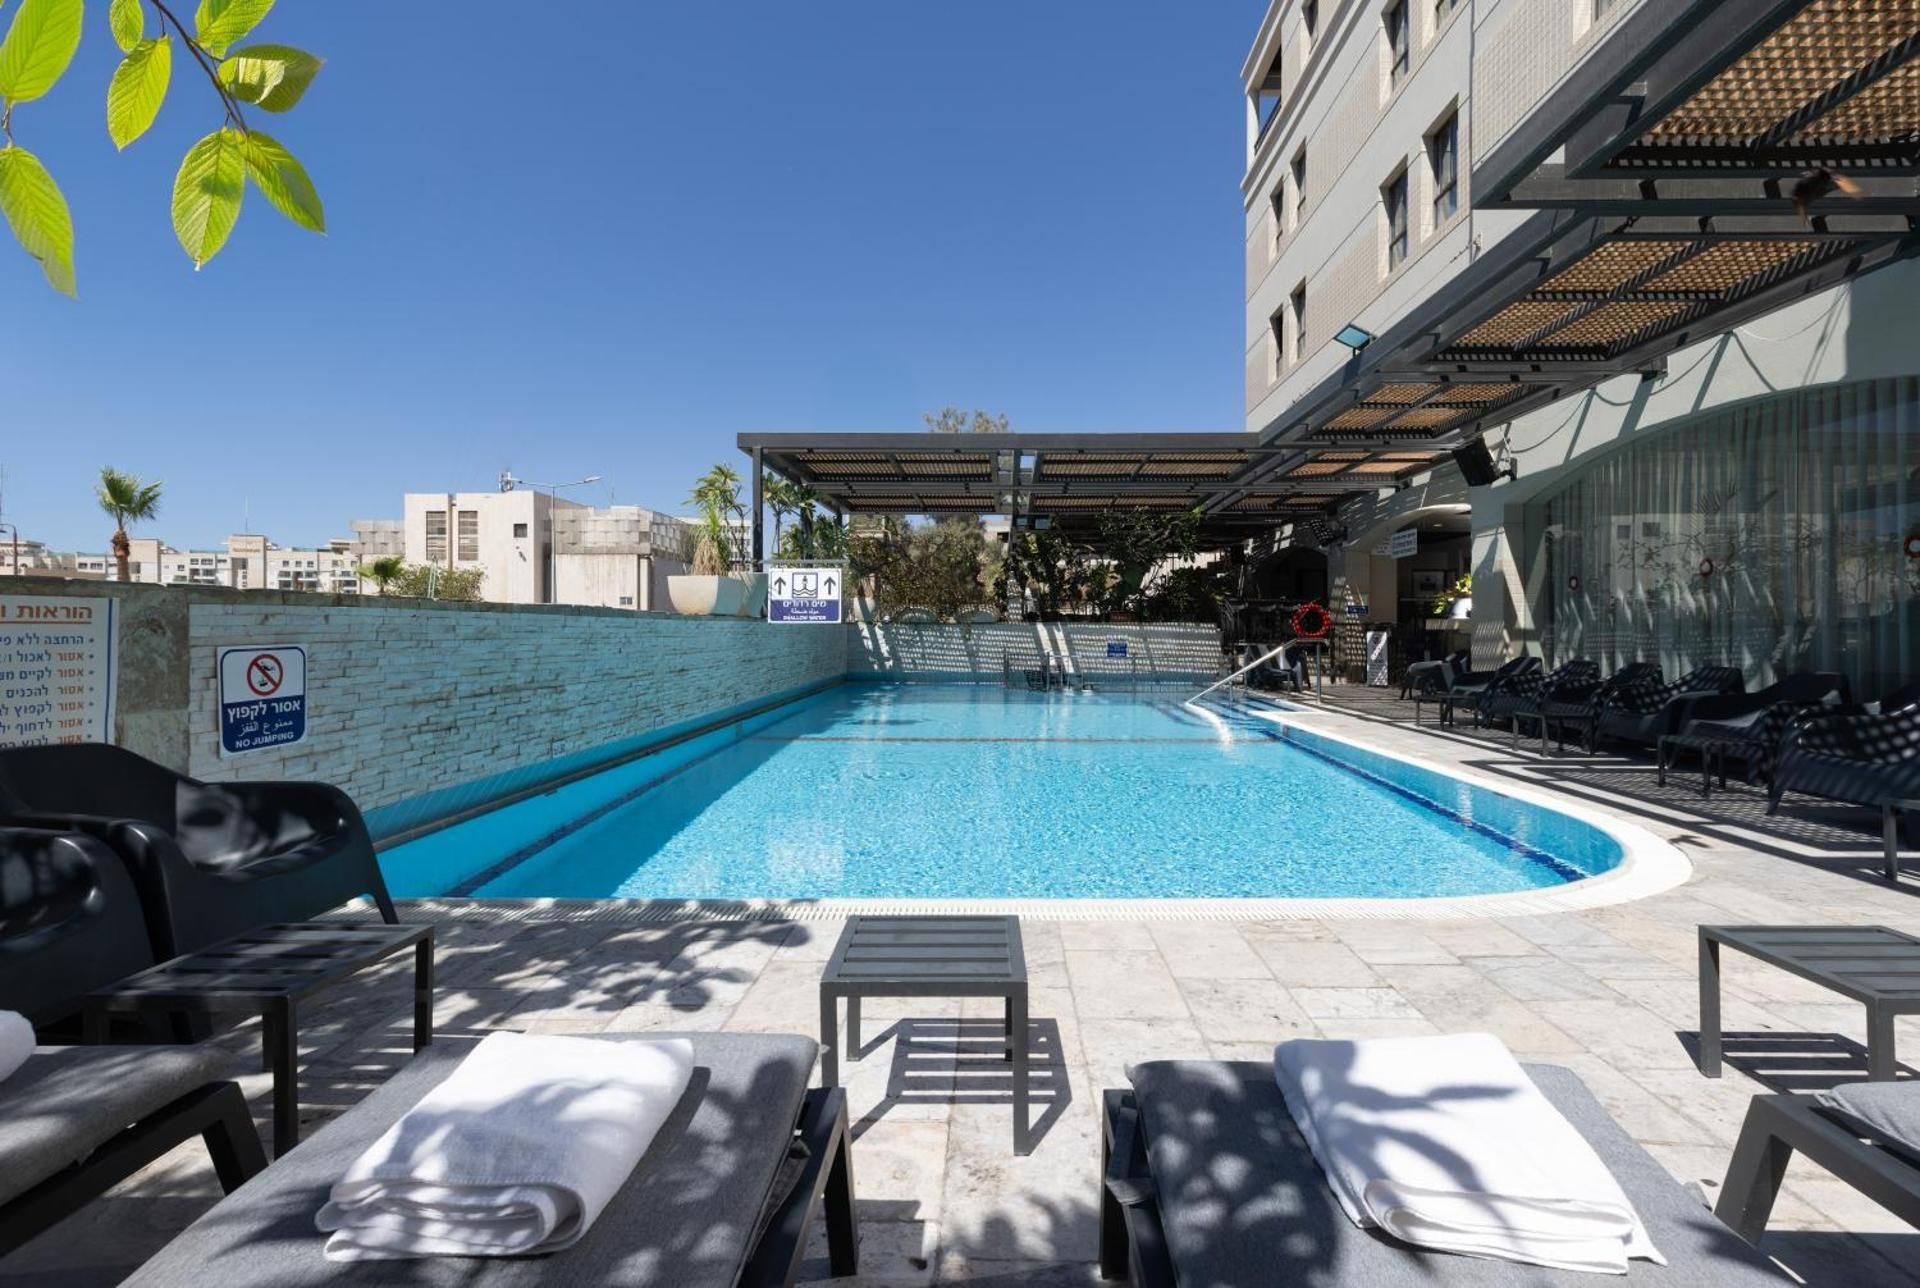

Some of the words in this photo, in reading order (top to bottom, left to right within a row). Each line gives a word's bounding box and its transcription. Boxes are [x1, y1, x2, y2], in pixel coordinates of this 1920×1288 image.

[16, 605, 92, 618] הוראות
[17, 632, 39, 645] ללא
[44, 635, 84, 645] הרחצה
[17, 650, 51, 662] לאכול
[57, 651, 84, 661] אסור
[20, 666, 52, 681] לקיים
[57, 668, 84, 678] אסור
[57, 685, 84, 695] אסור
[14, 700, 52, 717] לקפוץ
[57, 701, 84, 711] אסור
[227, 701, 267, 723] לקפוץ
[271, 700, 301, 714] אסור
[15, 718, 52, 735] לדחוף
[57, 718, 83, 729] אסור
[57, 735, 82, 745] אסור
[235, 739, 250, 749] NO
[252, 731, 294, 746] JUMPING
